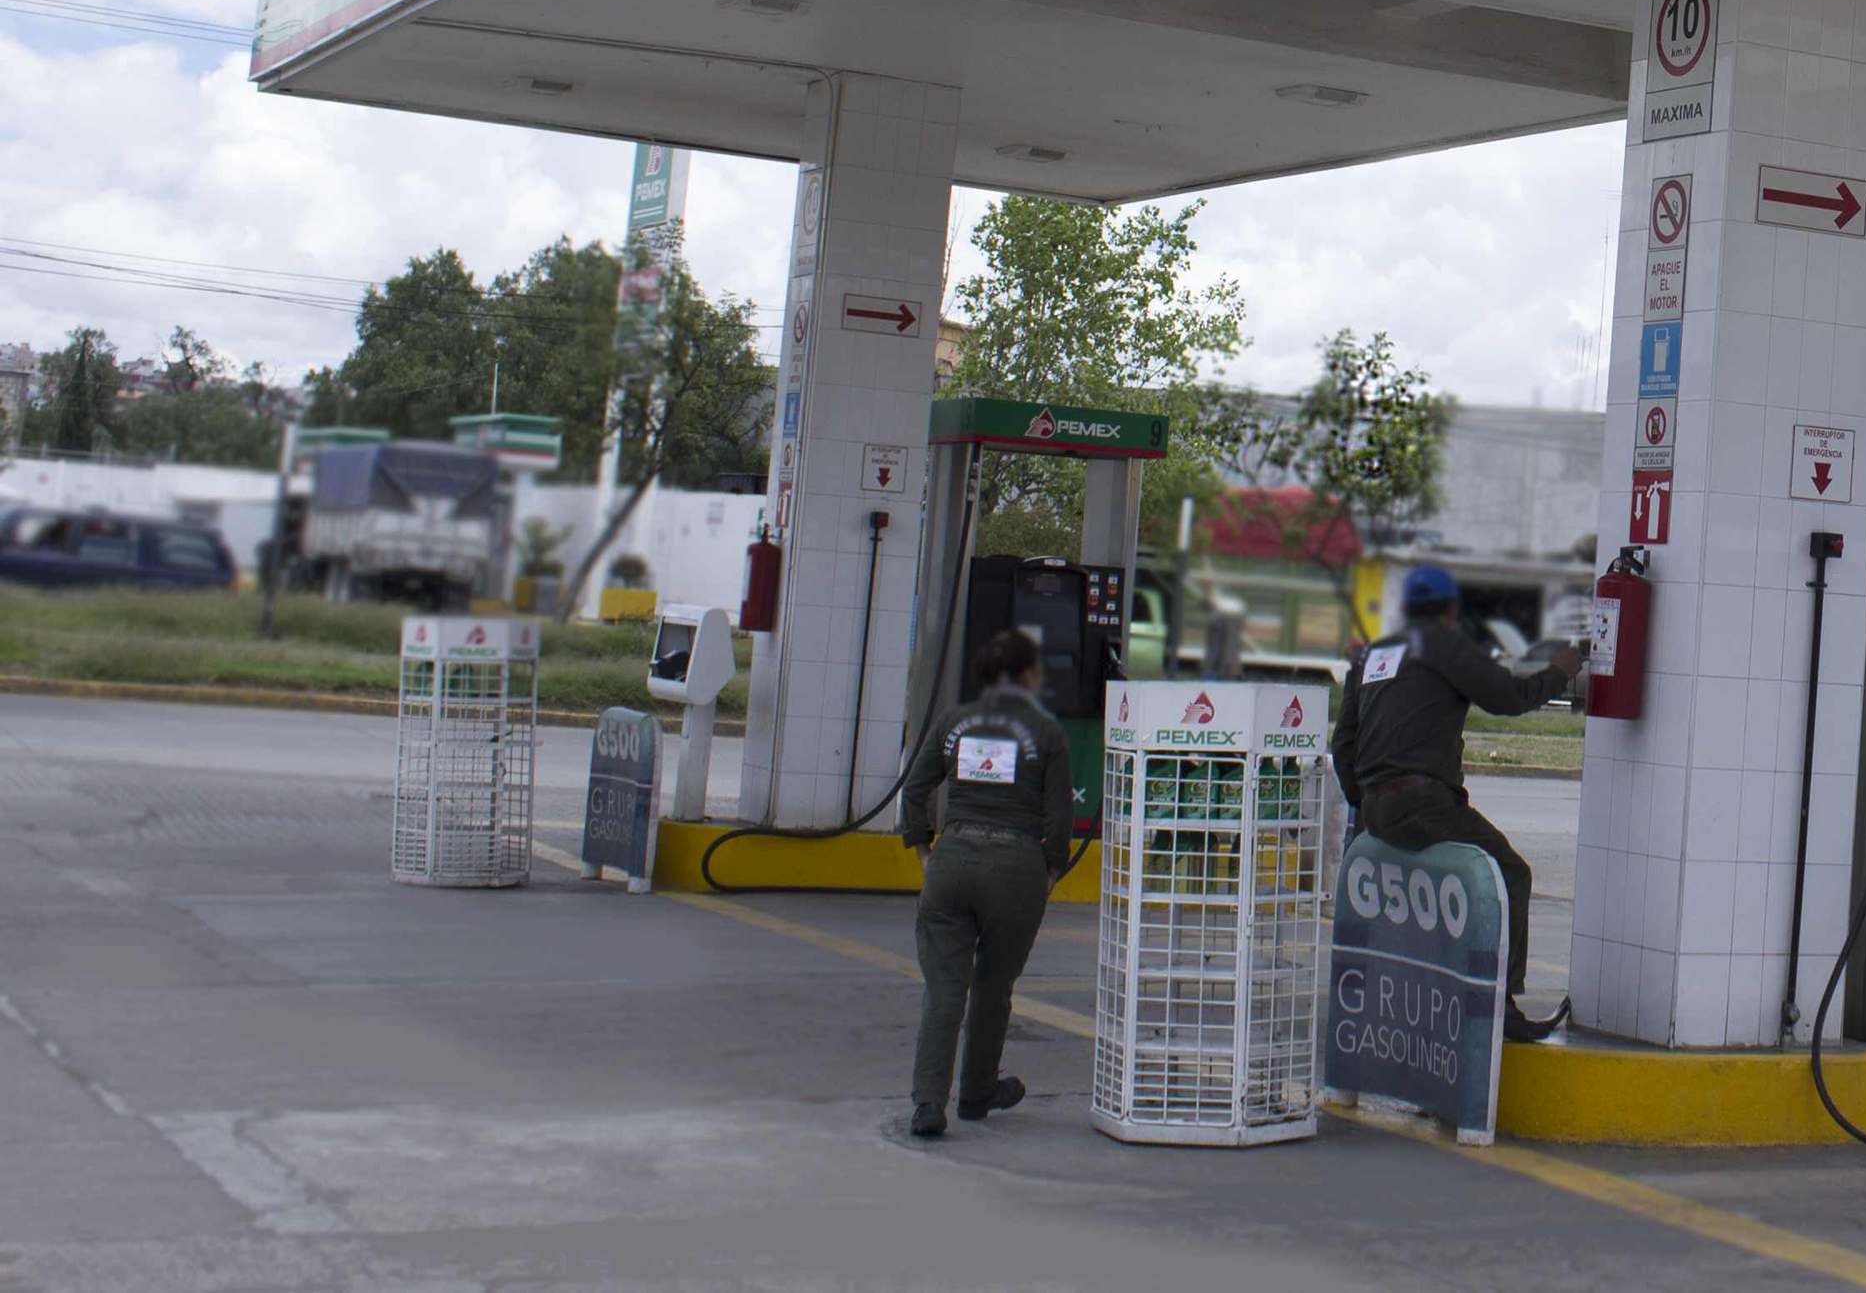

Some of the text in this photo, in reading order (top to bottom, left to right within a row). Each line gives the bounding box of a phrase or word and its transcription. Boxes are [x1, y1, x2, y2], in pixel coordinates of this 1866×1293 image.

[1650, 102, 1704, 125] MAXIMA
[635, 178, 667, 203] PEMEX
[1651, 261, 1682, 276] APAGUE
[1660, 279, 1670, 291] EL
[1649, 296, 1678, 311] MOTOR
[1057, 420, 1121, 439] PEMEX
[1803, 429, 1846, 440] INTERRUPTOR
[1803, 447, 1843, 459] EMERGENCIA
[1110, 727, 1136, 743] PEMEX
[1156, 729, 1236, 746] PEMEX
[1264, 733, 1316, 748] PEMEX
[1348, 856, 1468, 939] G500
[1338, 969, 1461, 1042] GRUPO
[1335, 1019, 1458, 1085] GASOLINERO
